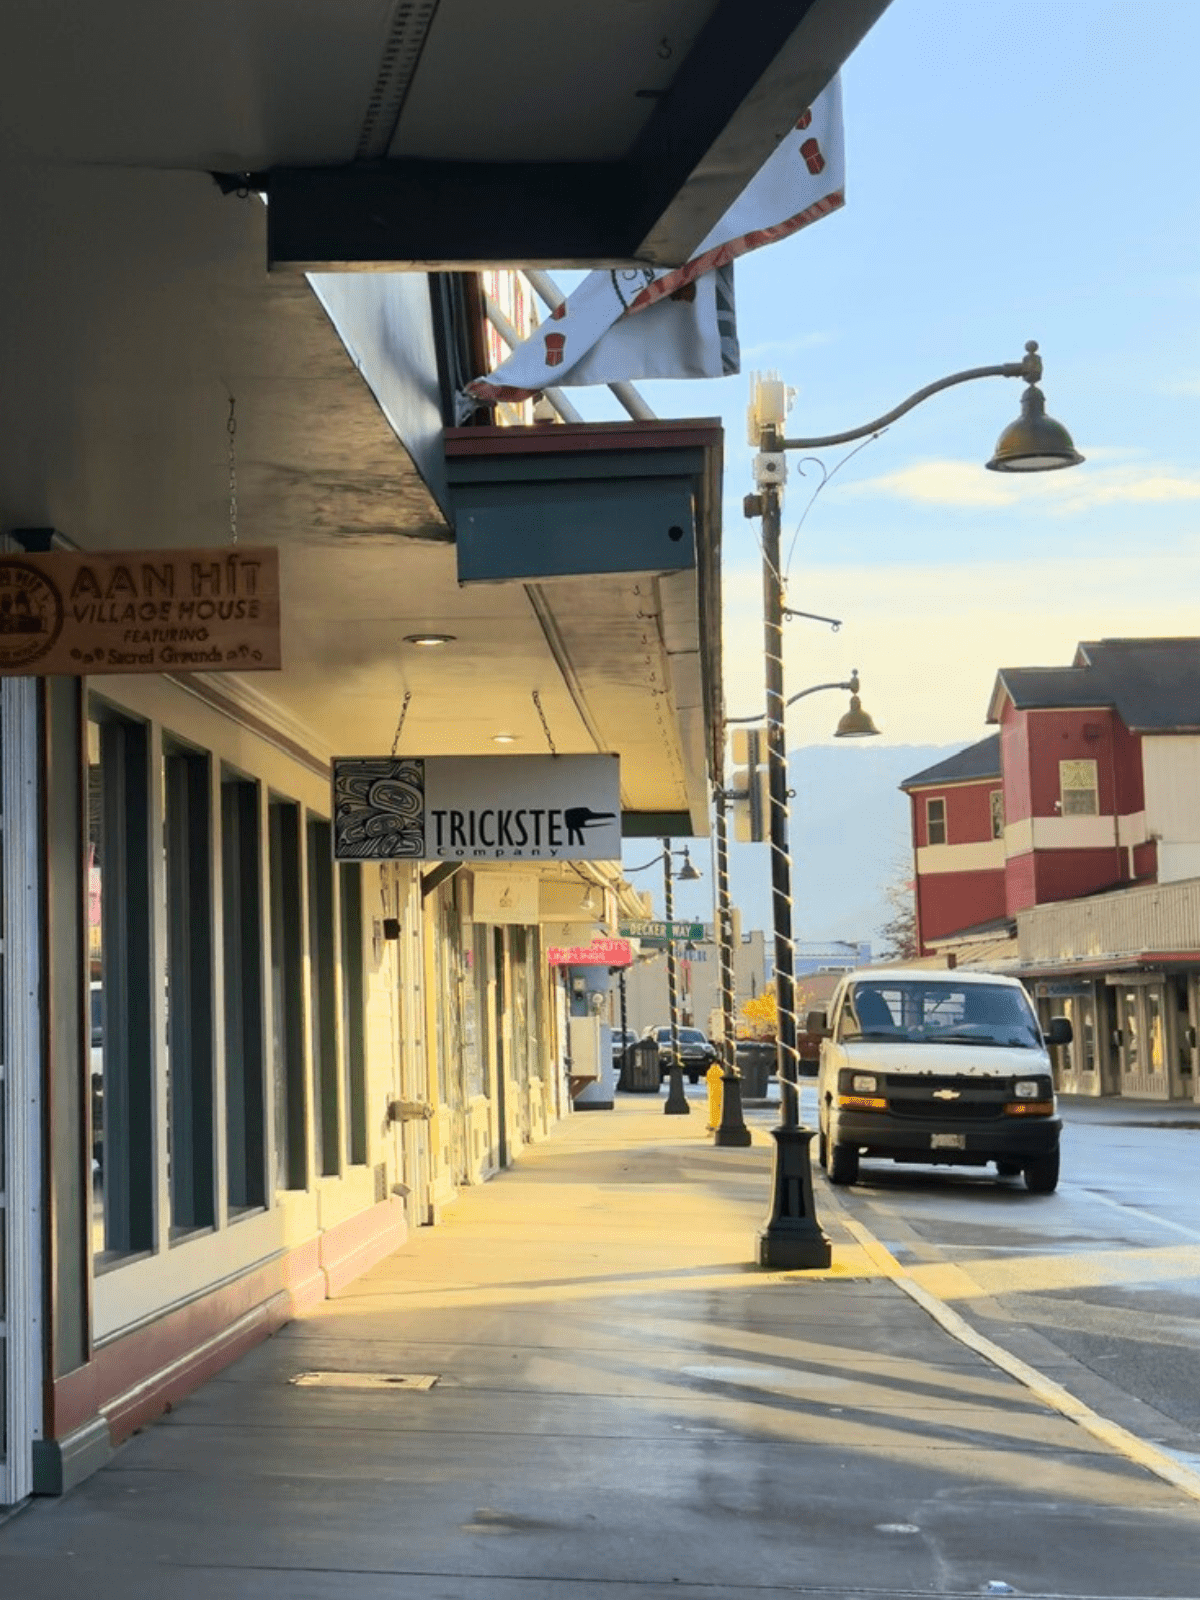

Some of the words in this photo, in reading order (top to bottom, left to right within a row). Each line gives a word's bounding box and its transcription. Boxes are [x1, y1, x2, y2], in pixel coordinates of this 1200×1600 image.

[70, 563, 174, 599] AAN
[71, 602, 171, 624] VILLAGE
[177, 600, 260, 621] HOUSE
[123, 627, 210, 644] FEATURING
[107, 645, 155, 665] Sacred
[158, 644, 224, 664] Grounds
[431, 807, 590, 846] TRICKSTER
[436, 847, 560, 858] Company
[629, 922, 667, 936] DECKER
[672, 923, 692, 936] WAY
